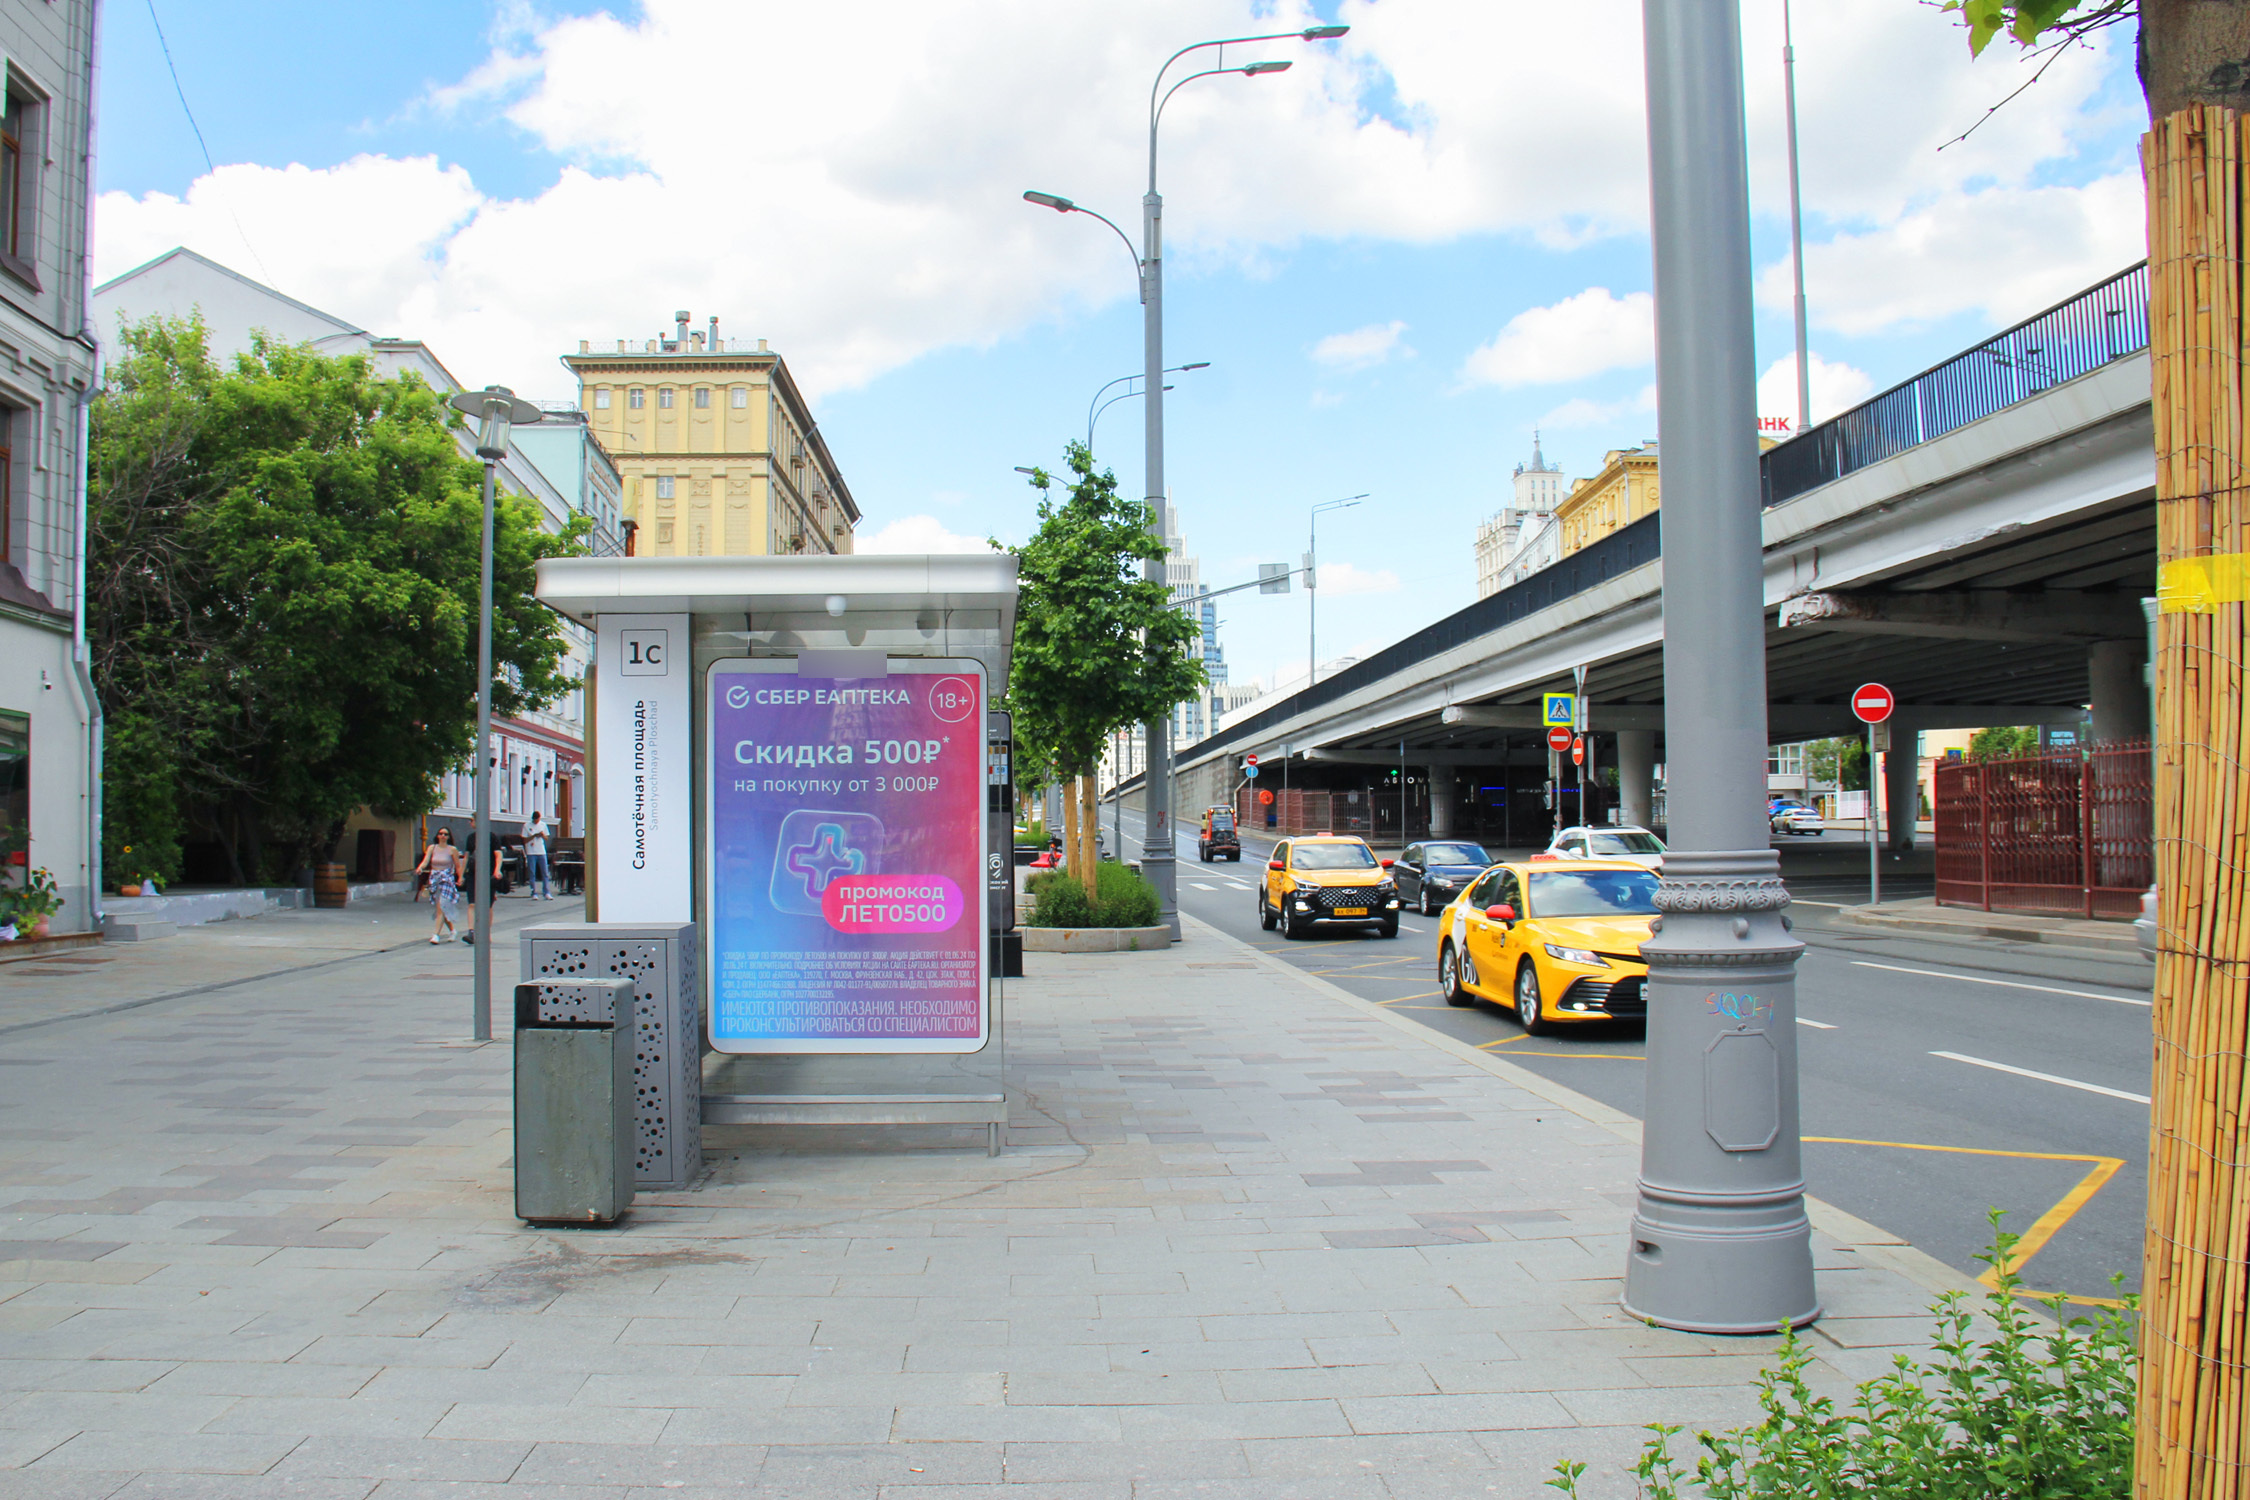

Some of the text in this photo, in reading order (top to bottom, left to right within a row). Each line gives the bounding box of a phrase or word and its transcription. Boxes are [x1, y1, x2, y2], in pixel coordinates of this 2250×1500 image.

[755, 689, 911, 704] СБЕР ЕАПТЕКА
[936, 692, 968, 709] 18+
[734, 740, 853, 768] Скидка
[648, 700, 661, 831] Samotyochnaya Ploschad
[632, 700, 646, 870] Самотёчная площадь
[734, 777, 939, 796] на покупку от 3 000₽
[840, 886, 945, 903] промокод
[828, 951, 836, 960] НА
[837, 951, 862, 960] ПОКУПКУ
[863, 951, 870, 960] ОТ
[909, 951, 938, 960] ДЕЙСТВУЕТ
[967, 951, 976, 960] ПО
[881, 961, 889, 969] НА
[940, 961, 976, 969] ОРГАНИЗАТОР
[855, 970, 893, 979] ФРУНЗЕНСКАЯ
[959, 980, 976, 989] ЗНАКА
[721, 1000, 977, 1018] ИМЕЮТСЯ ПРОТИВОПОКАЗАНИЯ. НЕОБХОДИМО
[722, 1016, 977, 1034] ПРОКОНСУЛЬТИРОВАТЬСЯ СО СПЕЦИАЛИСТОМ
